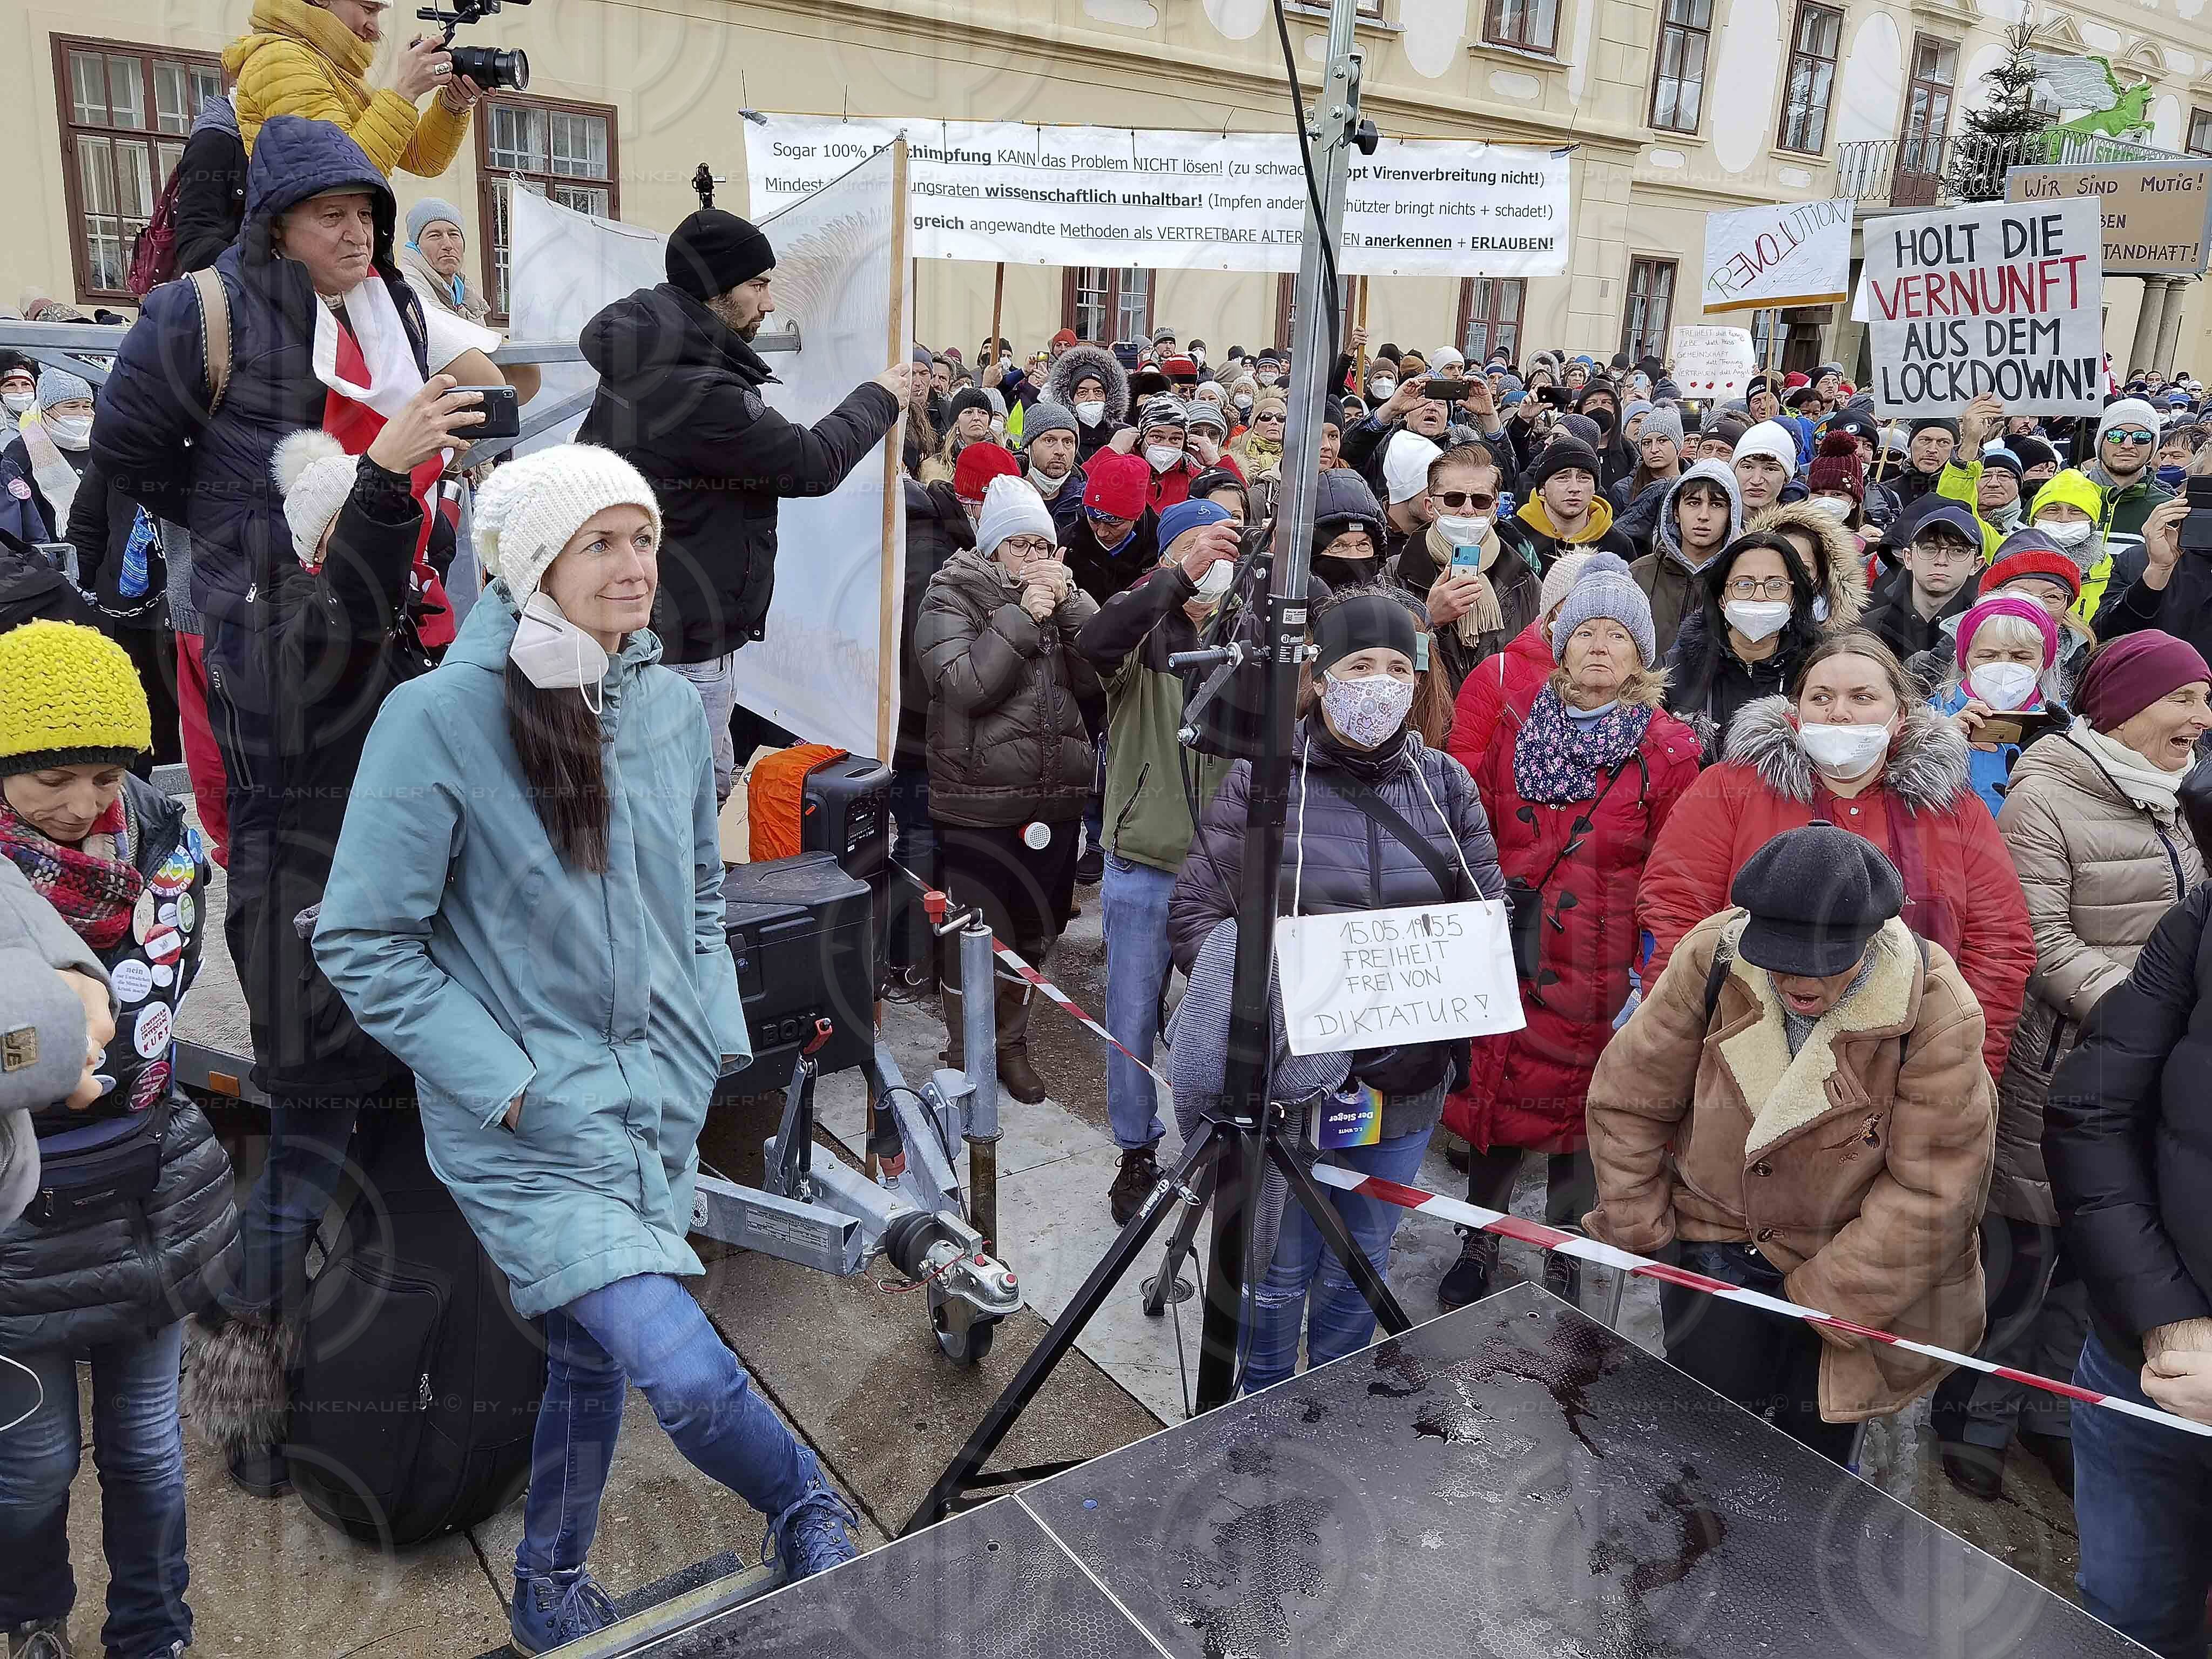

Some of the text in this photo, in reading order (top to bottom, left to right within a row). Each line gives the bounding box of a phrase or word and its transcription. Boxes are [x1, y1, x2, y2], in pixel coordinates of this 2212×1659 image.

[773, 142, 817, 160] Sogar
[824, 144, 867, 158] 100%
[998, 150, 1036, 166] KANN
[1041, 153, 1066, 168] das
[1071, 154, 1128, 170] Problem
[1134, 158, 1178, 172] NICHT
[1183, 158, 1223, 173] lösen!
[1228, 160, 1250, 177] (zu
[1255, 161, 1306, 176] schwac
[1373, 166, 1496, 186] Virenverbreitung
[1501, 170, 1545, 188] nicht!)
[985, 183, 1116, 203] wissenschaftlich
[1122, 191, 1203, 206] unhaltbar!
[1209, 193, 1262, 211] (Impfen
[1266, 195, 1306, 210] ander
[1344, 199, 1391, 214] hützter
[1395, 200, 1435, 218] bringt
[1439, 201, 1475, 216] nichts
[1480, 205, 1490, 215] +
[1495, 203, 1553, 220] schadet!)
[970, 219, 1055, 235] angewandte
[1060, 222, 1129, 238] Methoden
[1134, 225, 1152, 239] als
[1157, 226, 1257, 242] VERTRETBARE
[1365, 234, 1452, 248] anerkennen
[1458, 238, 1466, 248] +
[1471, 235, 1554, 249] ERLAUBEN!
[1894, 213, 2063, 269] HOLT DIE
[2102, 242, 2199, 263] TANDHAFT!
[1871, 254, 2088, 321] VERNUNFT
[1901, 317, 2061, 362] AUS DEM
[1881, 357, 2098, 405] LOCKDOWN!
[1343, 940, 1449, 969] FREIHEIT
[1345, 966, 1441, 994] FREI VON
[1328, 1113, 1357, 1122] Sieger
